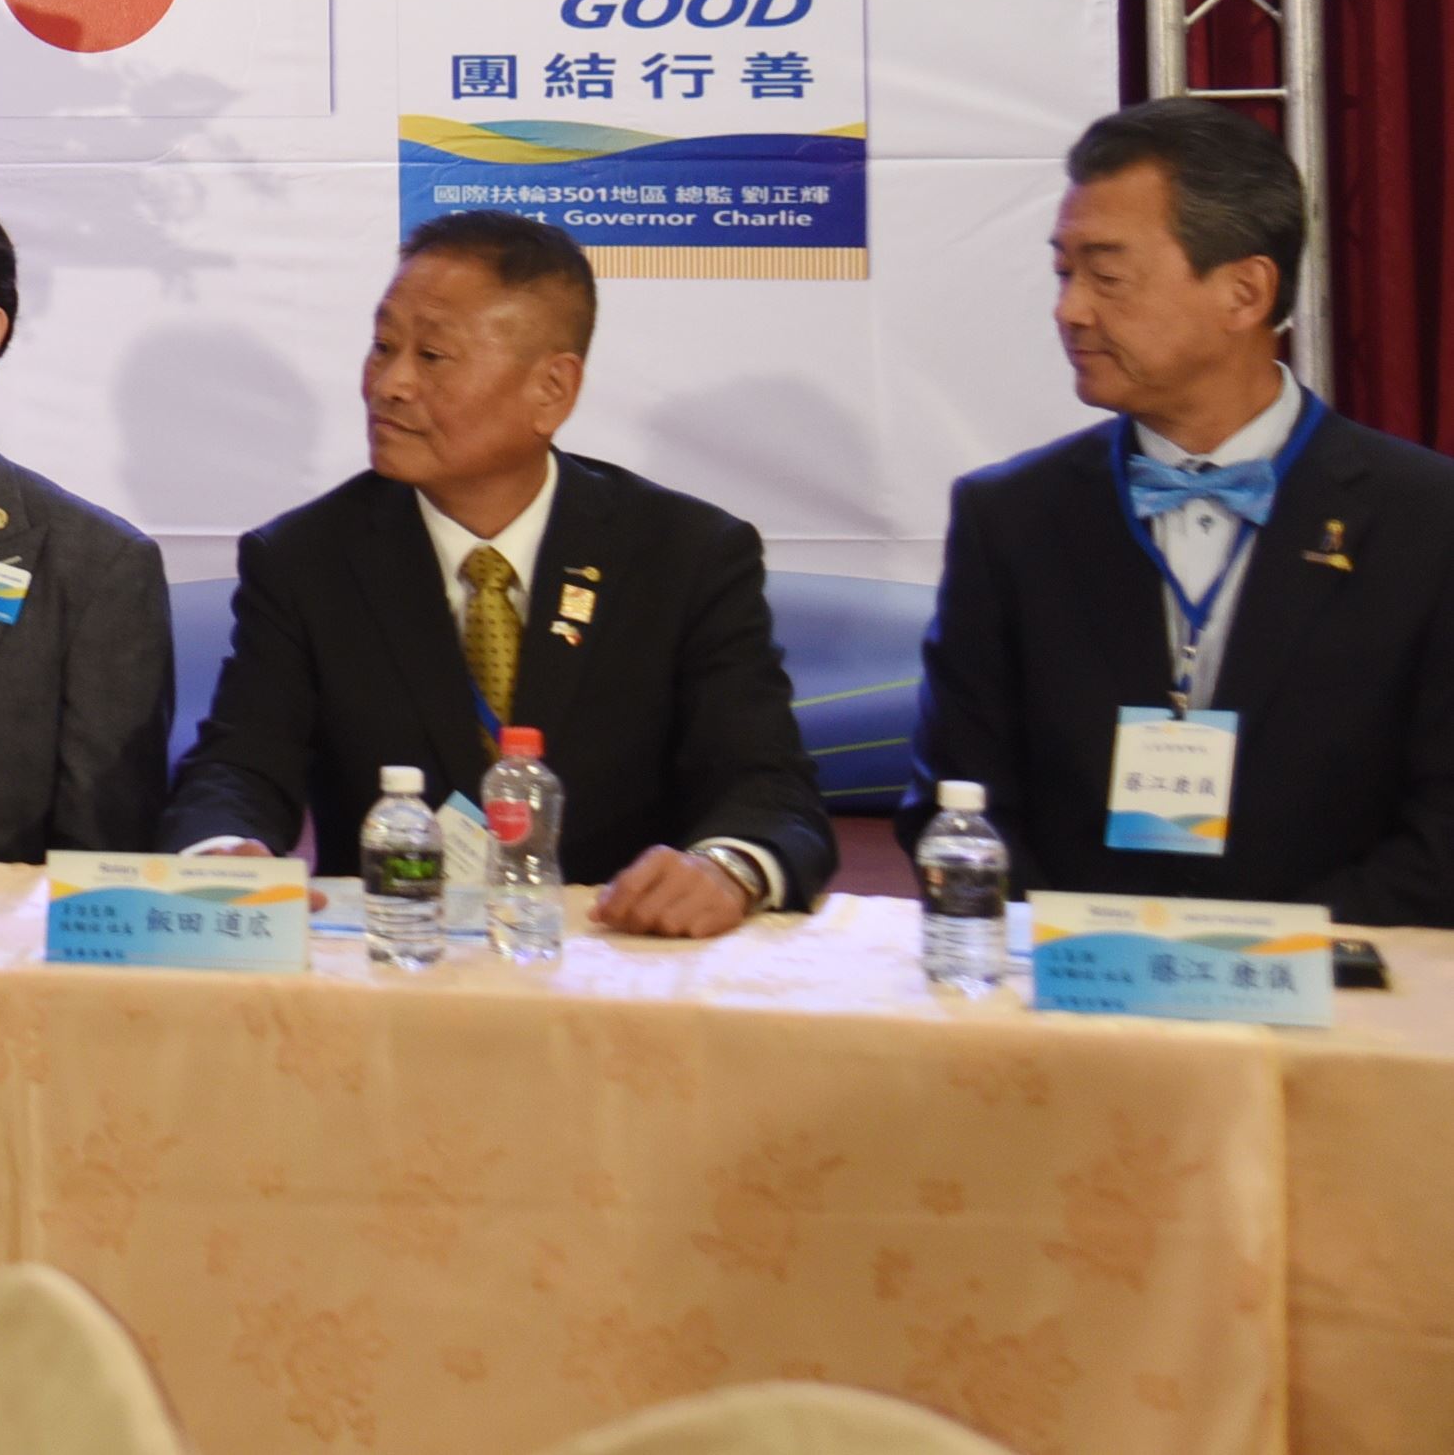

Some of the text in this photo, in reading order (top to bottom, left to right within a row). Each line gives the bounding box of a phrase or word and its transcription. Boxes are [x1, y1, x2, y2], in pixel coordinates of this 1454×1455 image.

[452, 51, 815, 101] 團結行善
[563, 209, 697, 228] Governor
[712, 209, 814, 228] Charlie
